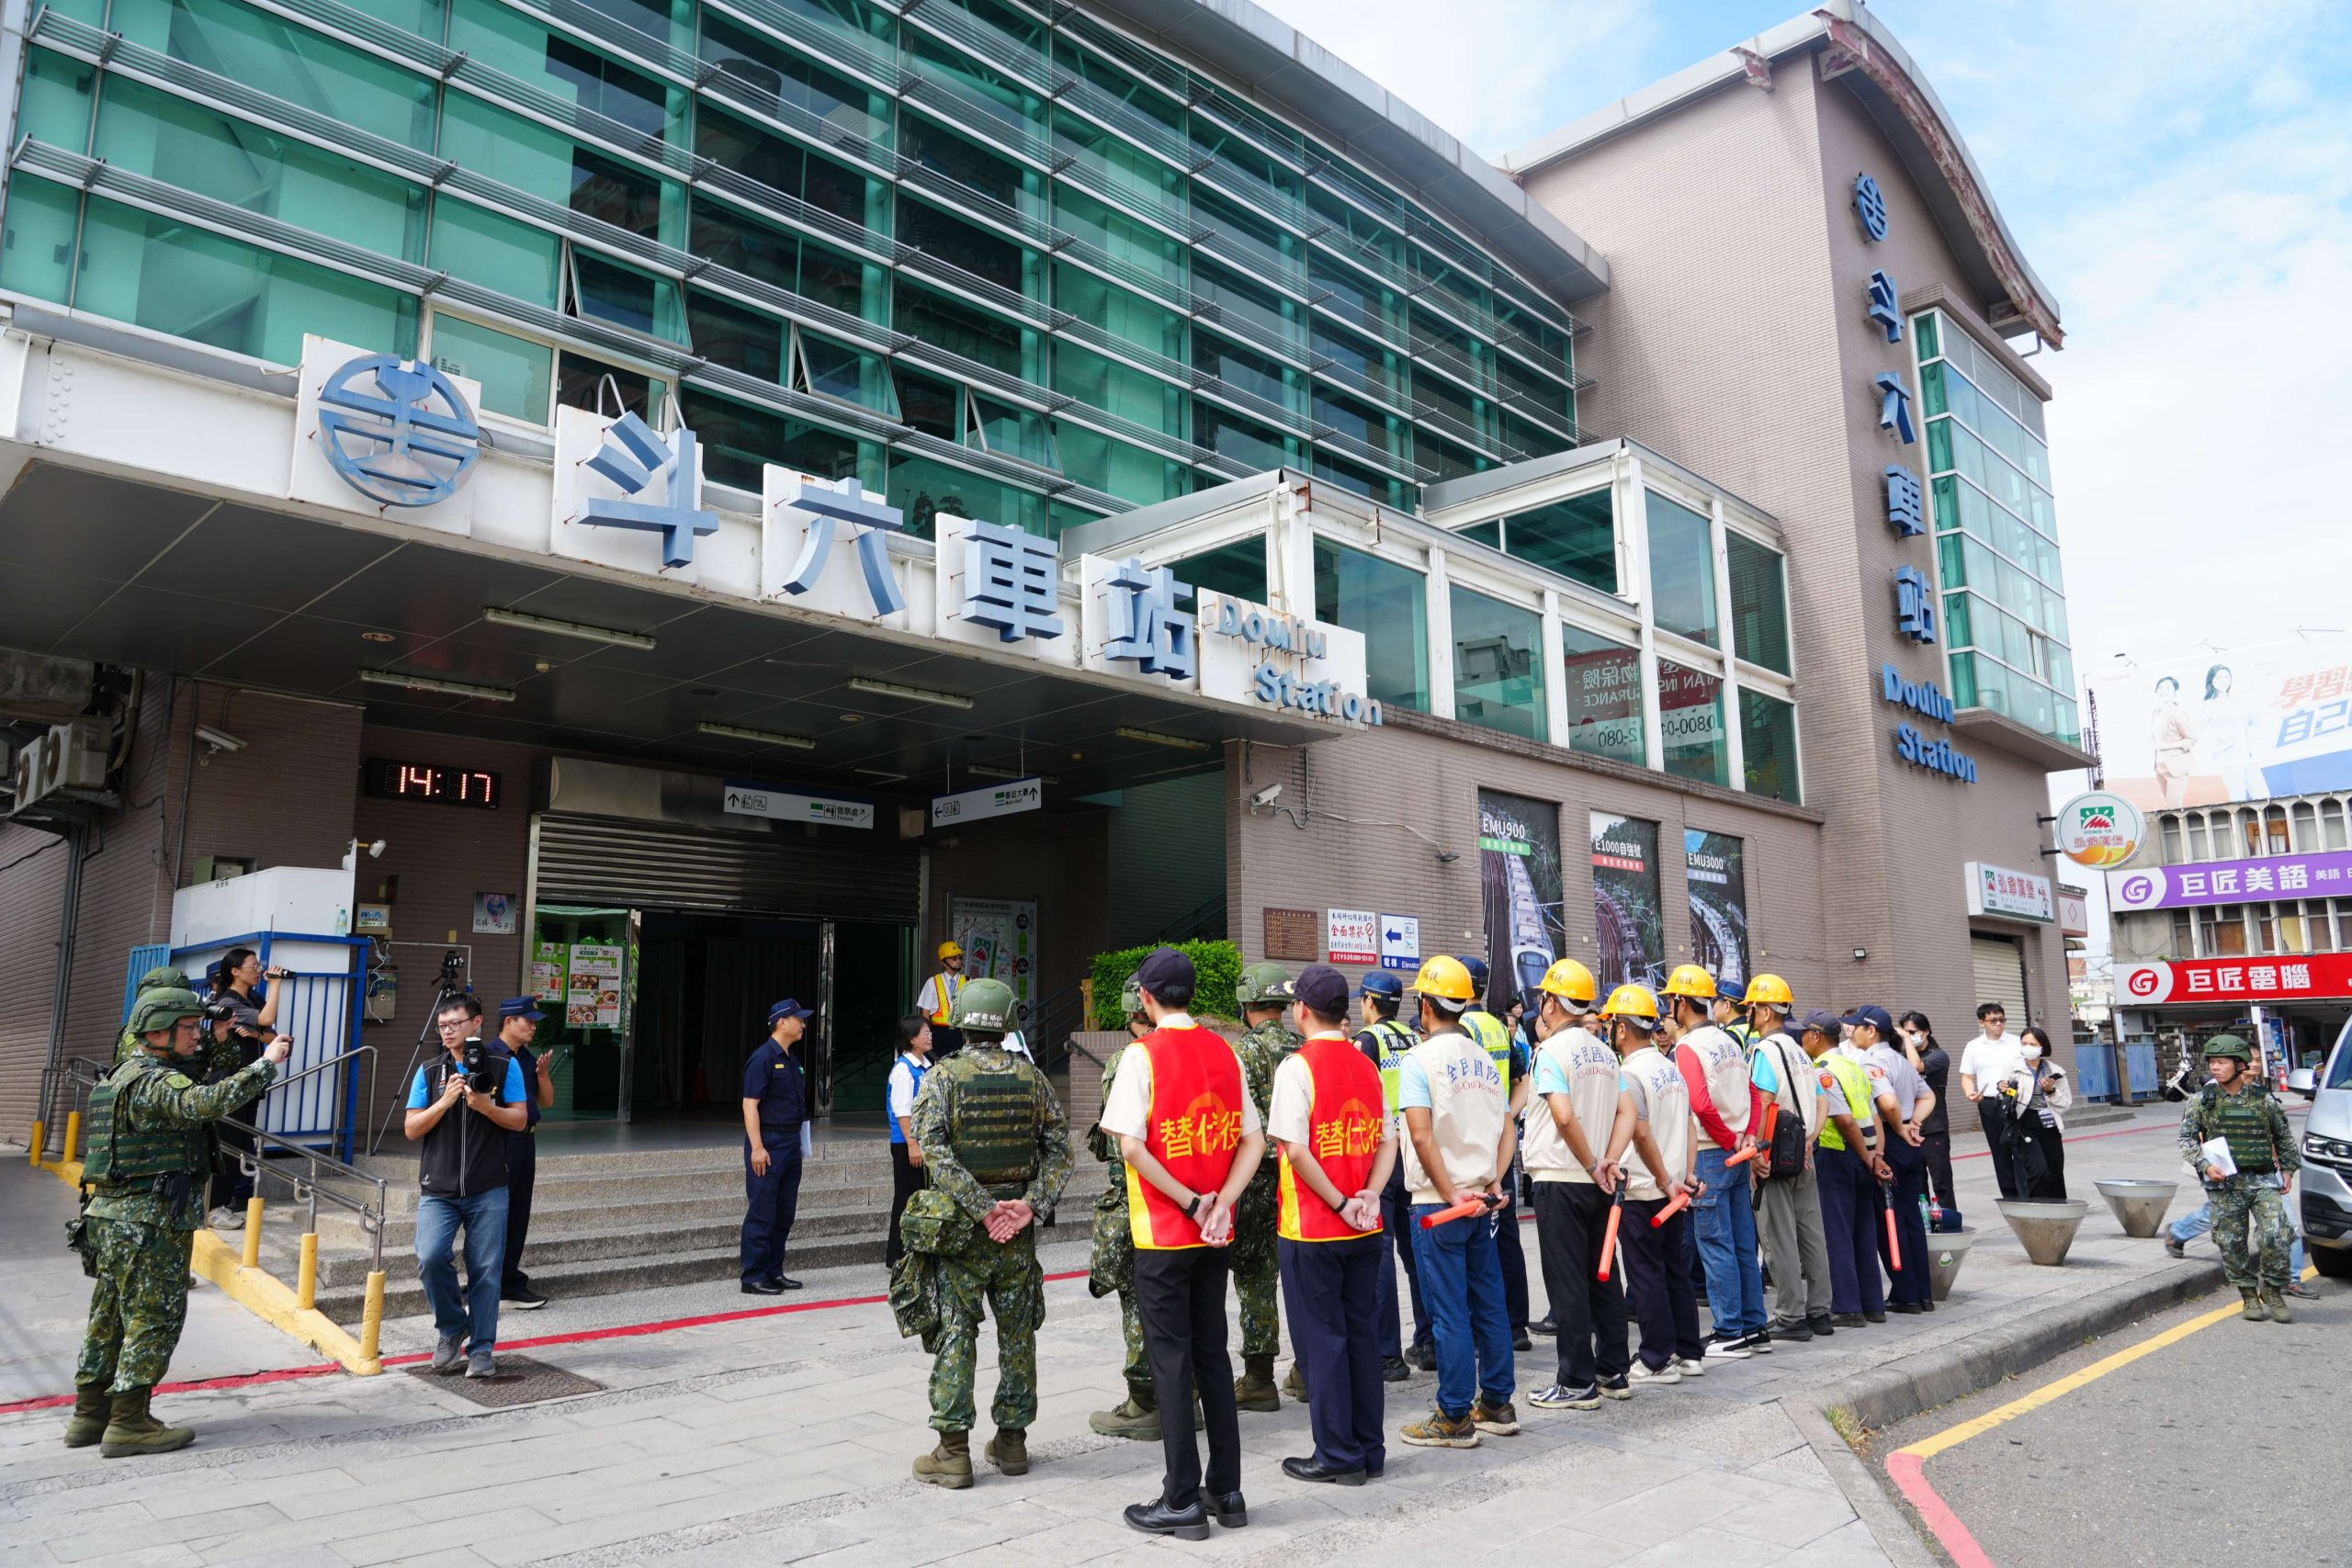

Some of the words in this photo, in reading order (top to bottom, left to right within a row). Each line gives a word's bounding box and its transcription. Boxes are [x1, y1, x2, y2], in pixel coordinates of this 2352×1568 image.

[1869, 268, 1936, 644] 斗六車站
[576, 410, 1195, 681] 斗六車站
[1212, 593, 1328, 660] Douliu
[1254, 661, 1383, 727] Station
[1883, 661, 1955, 725] Douliu
[2279, 666, 2352, 710] 學習
[2276, 699, 2352, 749] 自己
[1897, 720, 1979, 784] Station
[399, 765, 492, 803] 14:17
[1483, 817, 1525, 839] EMU900
[1595, 838, 1642, 859] E1000自強號
[1688, 852, 1724, 871] EMU3000
[2178, 863, 2309, 898] 巨匠美語
[2315, 868, 2341, 881] 美語
[1383, 957, 1397, 968] 電梯
[1401, 960, 1420, 970] Elevator
[2186, 964, 2312, 993] 巨匠電腦
[1446, 1057, 1500, 1085] 全民國防
[1572, 1046, 1616, 1070] 全民國防
[1159, 1110, 1243, 1160] 替代役
[1316, 1116, 1385, 1160] 替代役
